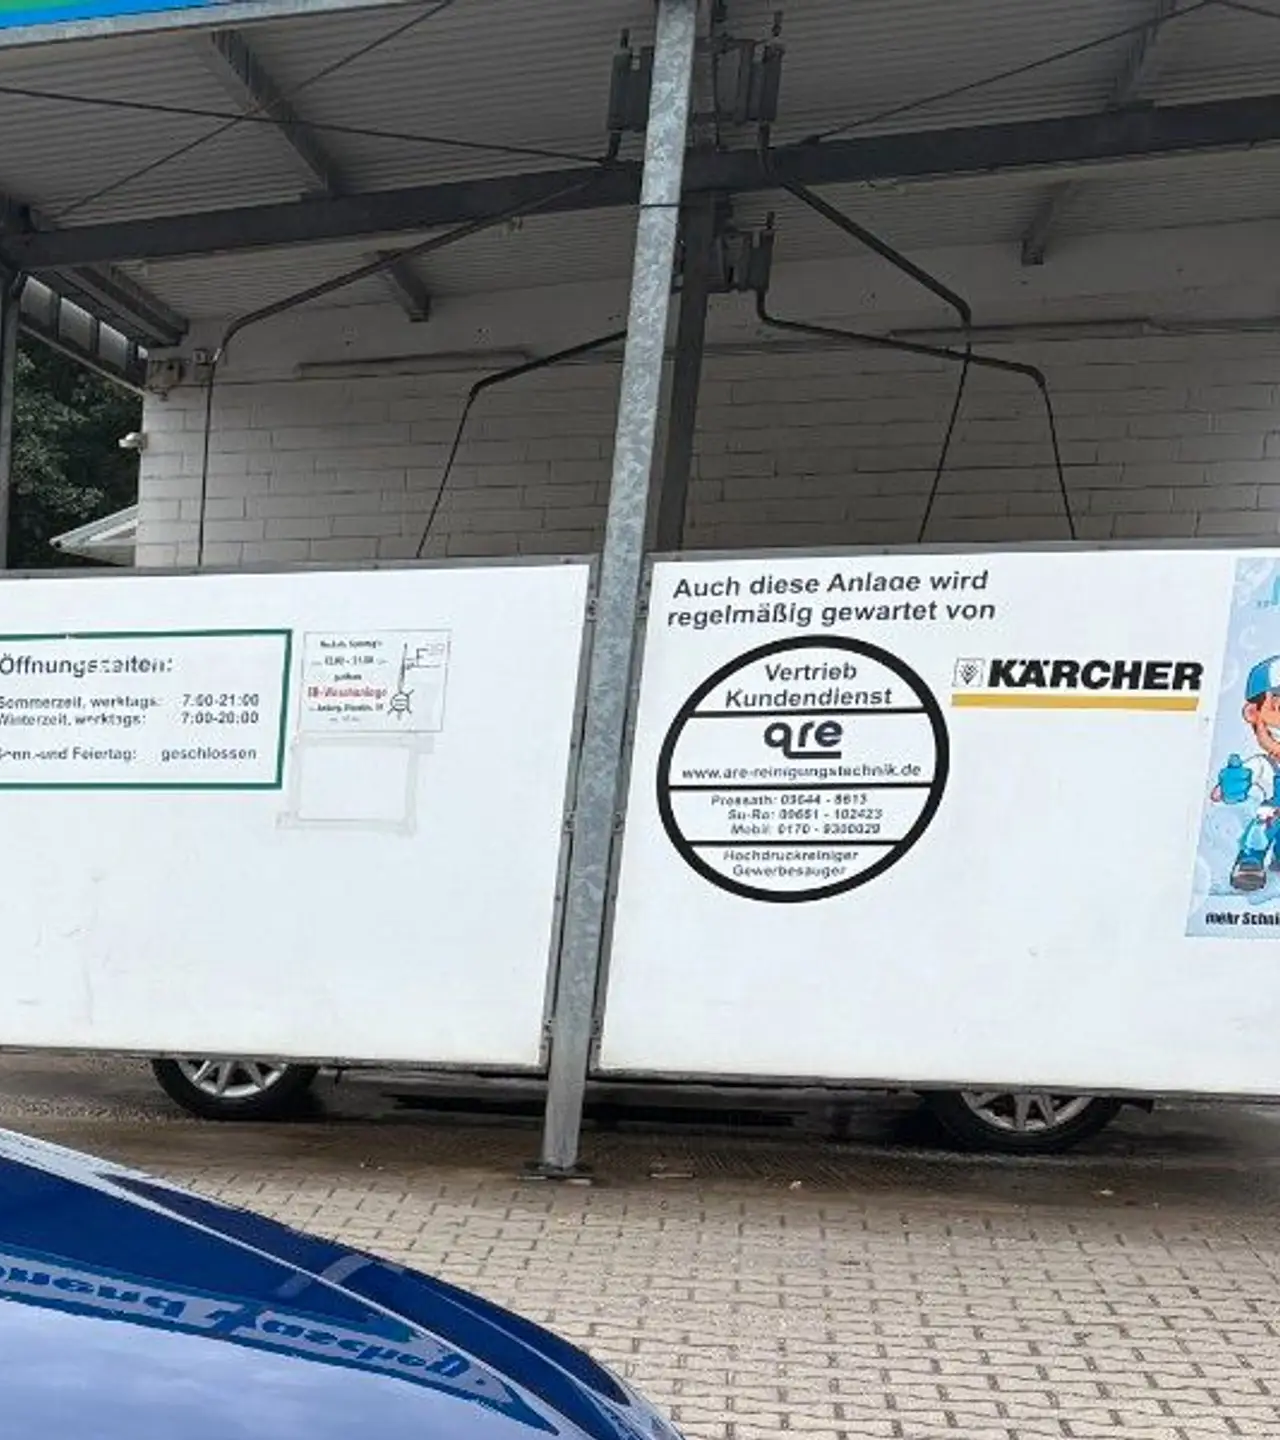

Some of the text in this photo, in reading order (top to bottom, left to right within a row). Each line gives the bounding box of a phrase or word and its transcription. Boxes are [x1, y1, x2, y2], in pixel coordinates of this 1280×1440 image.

[672, 577, 741, 599] Auch
[749, 574, 821, 596] diese
[929, 570, 989, 591] wird
[667, 601, 996, 630] regelmäßig gewartet von
[765, 661, 858, 682] Vertrieb
[987, 658, 1204, 691] KÄRCHER
[725, 687, 893, 709] Kundendienst
[73, 746, 138, 762] Feiertag:
[161, 746, 257, 762] geschlossen
[723, 849, 859, 863] Hochdruckreiniger
[1205, 911, 1240, 925] mehr
